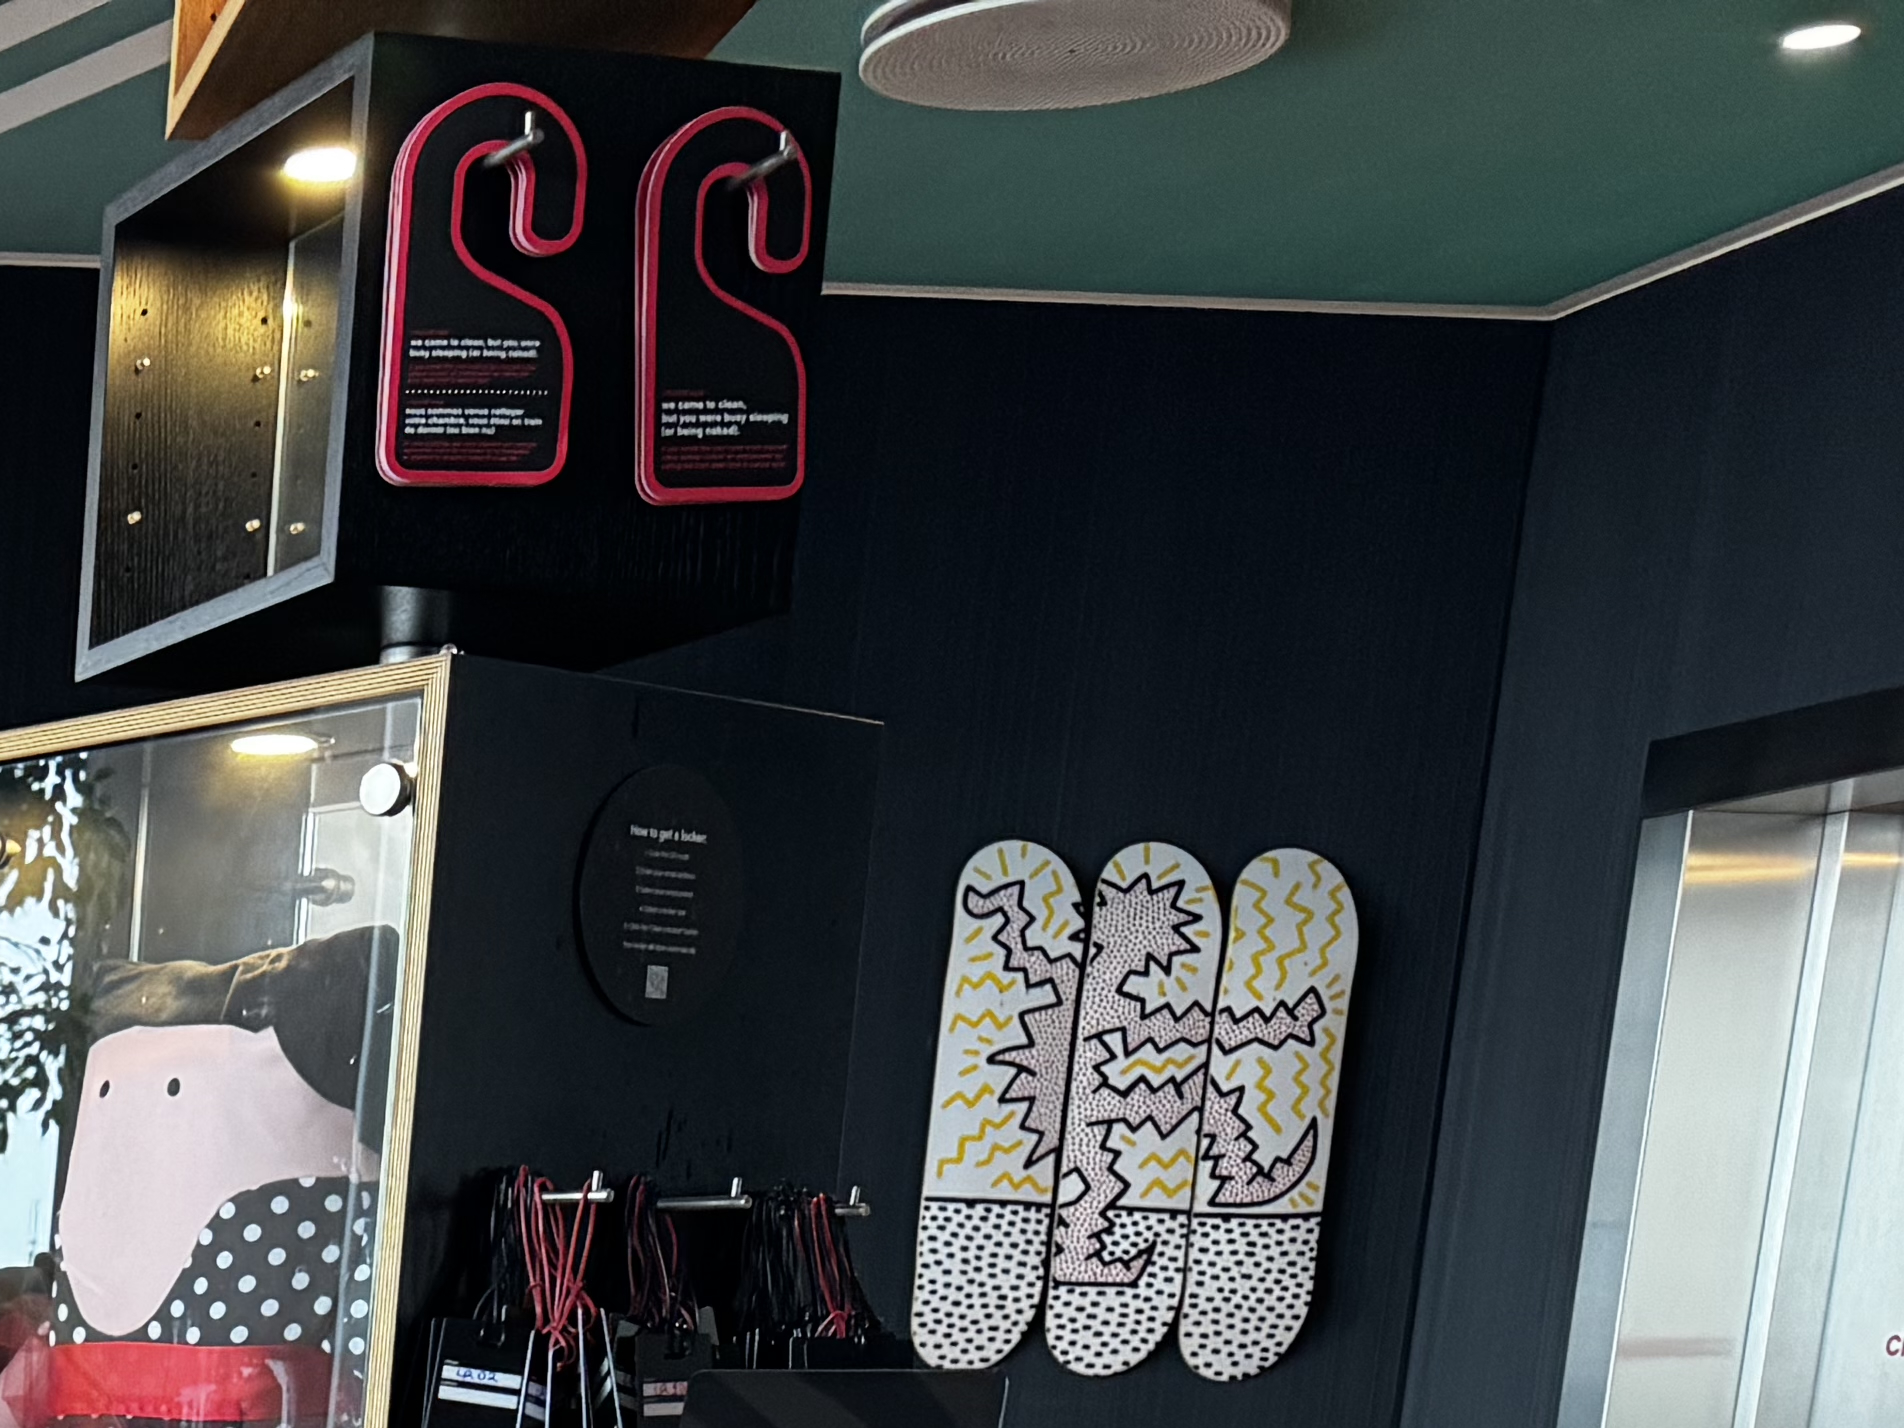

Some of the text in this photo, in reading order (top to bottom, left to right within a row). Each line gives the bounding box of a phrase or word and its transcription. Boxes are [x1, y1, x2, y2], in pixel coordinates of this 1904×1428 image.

[630, 824, 648, 837] How
[649, 828, 658, 839] to
[658, 829, 674, 842] get
[674, 830, 680, 841] a
